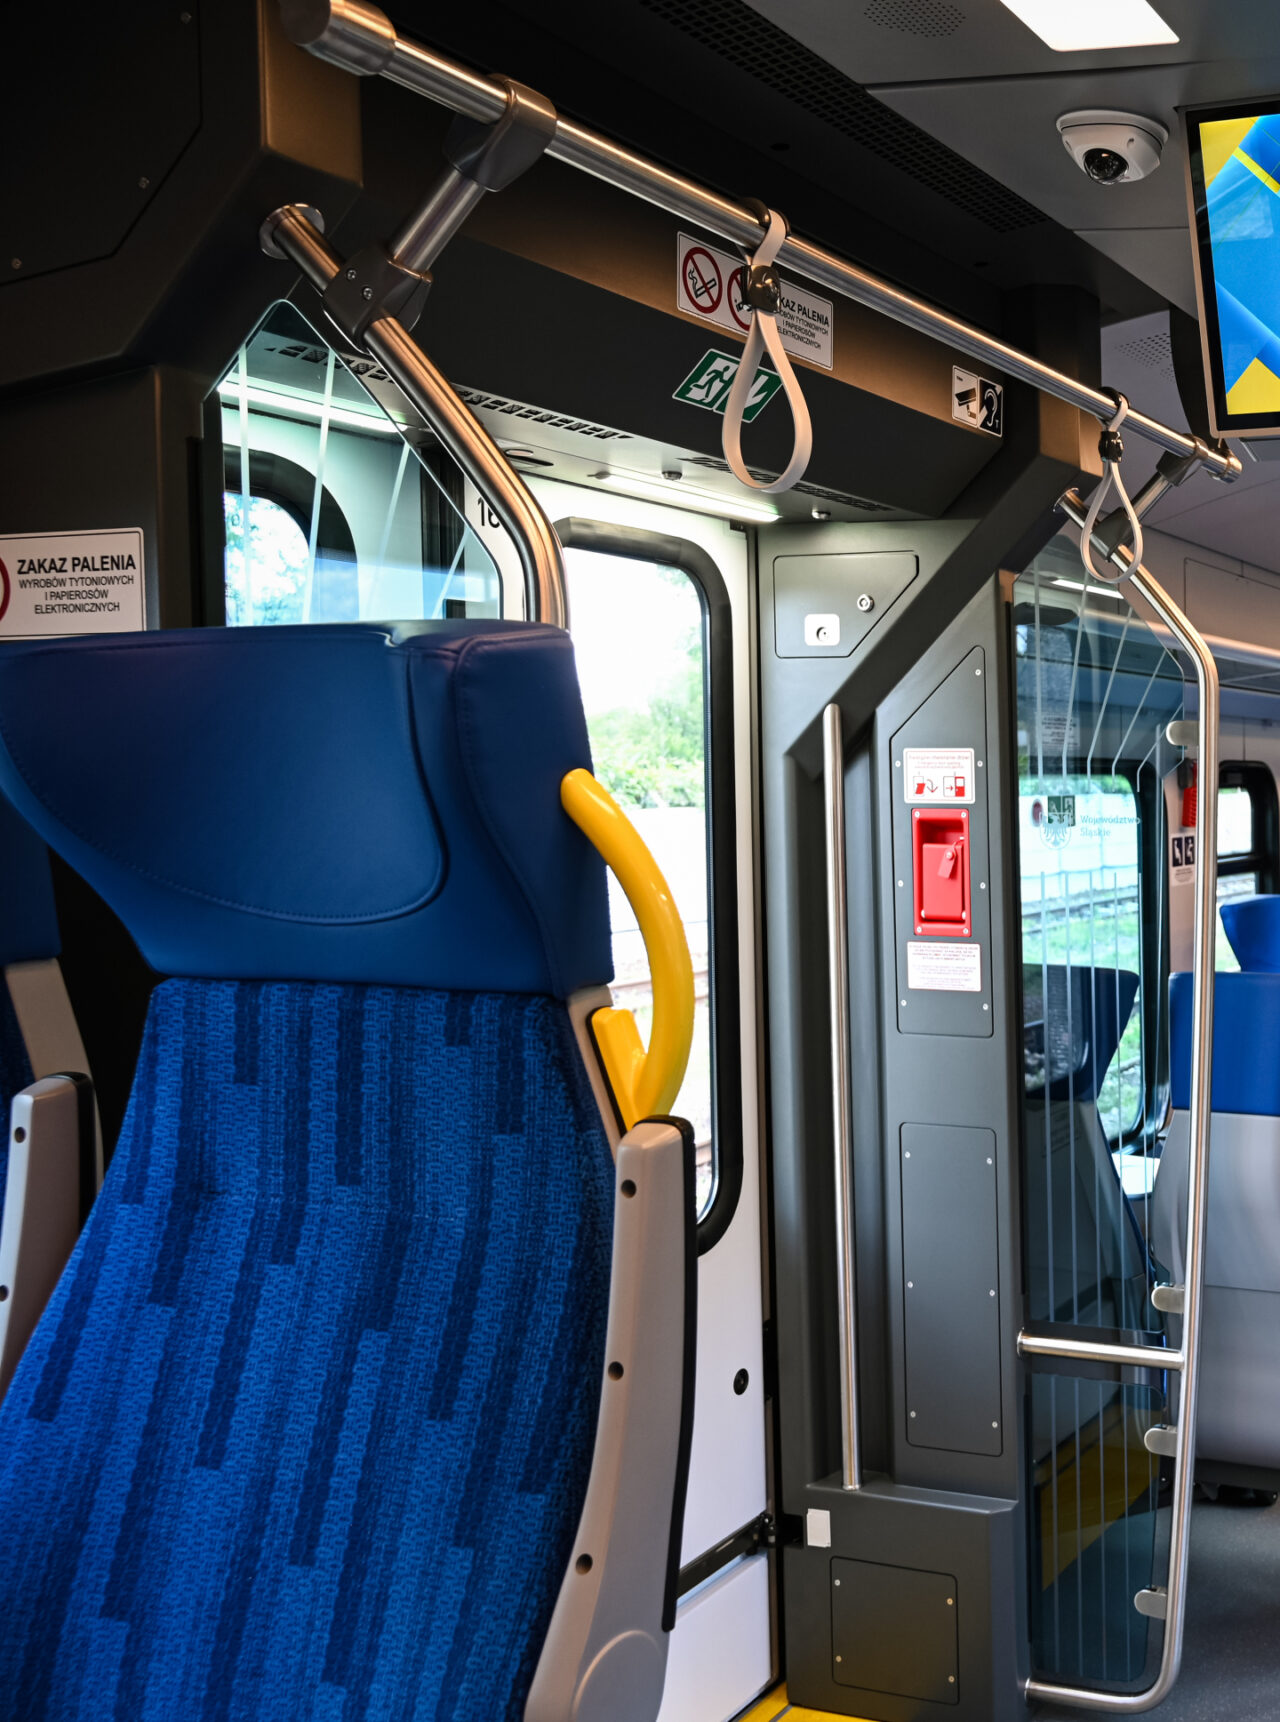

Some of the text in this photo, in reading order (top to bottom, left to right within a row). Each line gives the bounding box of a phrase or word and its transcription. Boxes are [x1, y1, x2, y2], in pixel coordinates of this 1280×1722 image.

[798, 304, 829, 327] PALENIA
[17, 554, 136, 575] ZAKAZ PALENIA
[19, 575, 134, 589] WYROBÓW TYTONIOWYCH
[45, 588, 109, 601] I PAPIEROSÓW
[34, 602, 120, 614] ELEKTRONICZNYCH
